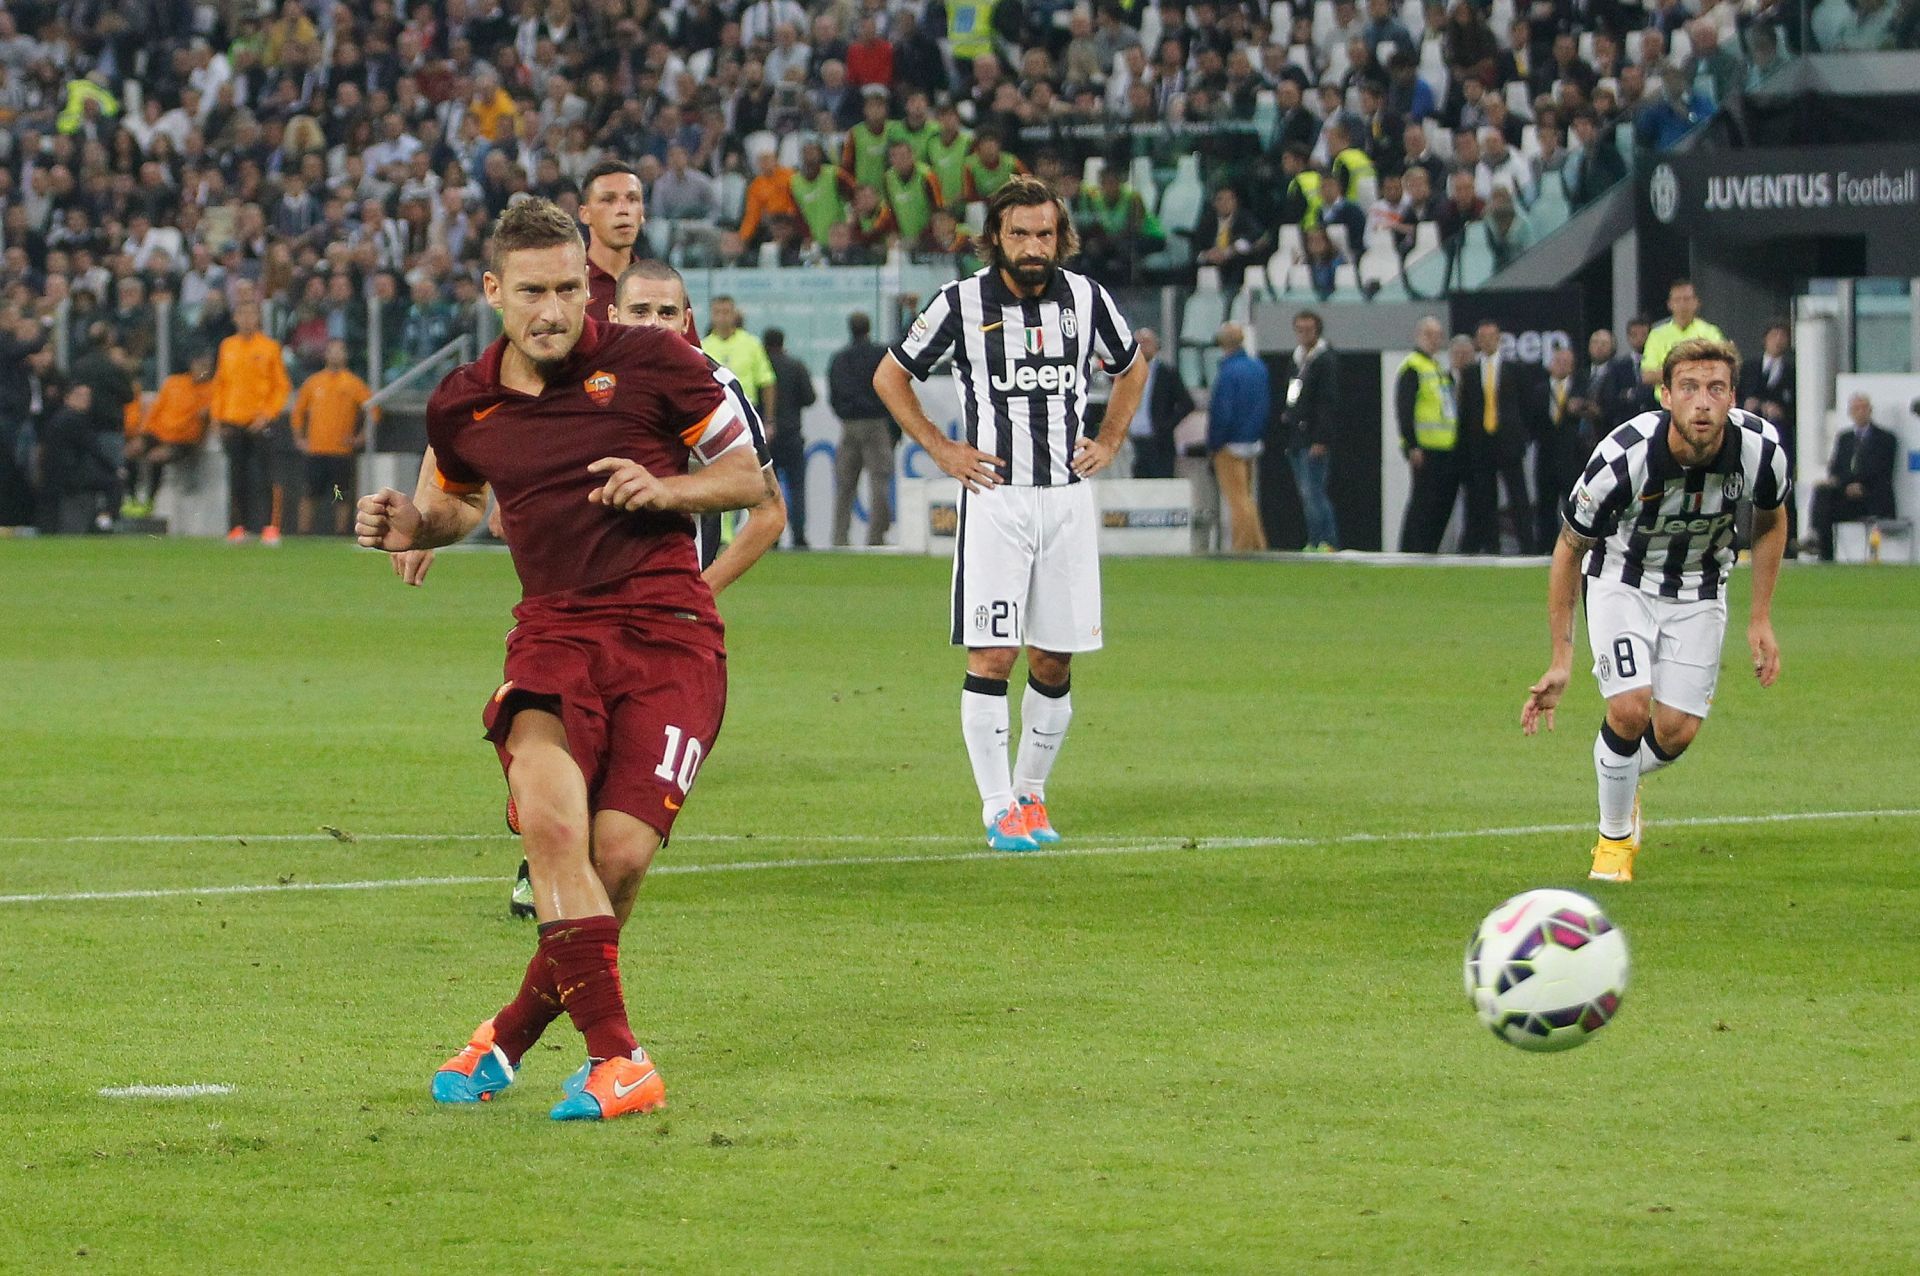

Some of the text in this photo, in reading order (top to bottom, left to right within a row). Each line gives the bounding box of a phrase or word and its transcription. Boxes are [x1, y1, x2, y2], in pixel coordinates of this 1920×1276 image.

[1704, 167, 1914, 211] JUVENTUS Football
[991, 359, 1076, 395] Jeep
[1637, 514, 1733, 544] Jeep
[992, 600, 1019, 639] 21
[1613, 637, 1637, 678] 8
[654, 724, 702, 795] 10
